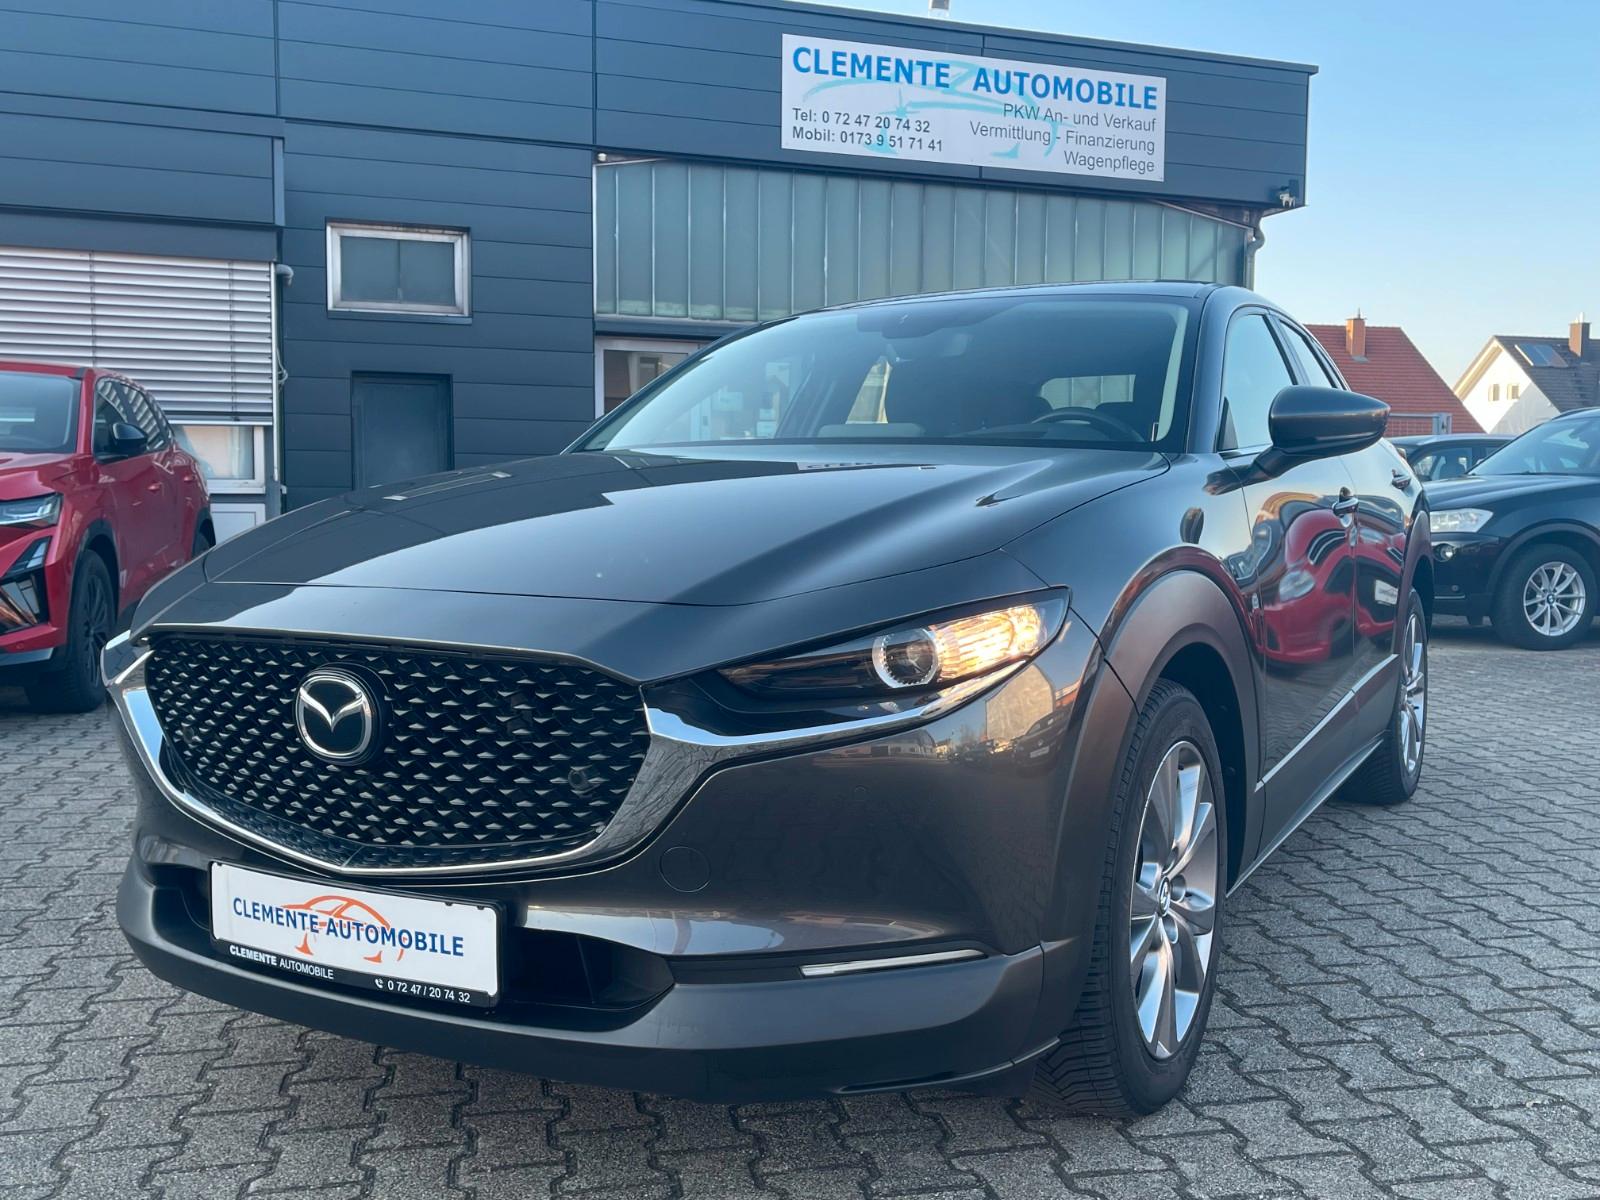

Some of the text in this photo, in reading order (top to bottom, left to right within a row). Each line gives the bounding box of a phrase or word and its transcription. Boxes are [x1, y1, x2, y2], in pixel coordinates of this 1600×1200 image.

[792, 47, 1158, 110] CLEMENTE AUTOMOBILE
[792, 108, 930, 132] Tel: 0 72 47 20 74 32
[1003, 104, 1156, 132] PKW An- und Verkauf
[792, 127, 943, 152] Mobil: 0173 9 51 71 41
[970, 121, 1051, 146] Vermittlung
[1066, 128, 1155, 154] Finanzierung
[1064, 151, 1154, 173] Wagenpflege
[233, 897, 464, 957] CLEMENTE AUTOMOBILE
[230, 944, 334, 980] CLEMENTE AUTOMOBILE
[388, 981, 394, 990] 0
[397, 982, 408, 993] 72
[429, 987, 440, 998] 20
[444, 989, 454, 1000] 74
[458, 991, 470, 1003] 32
